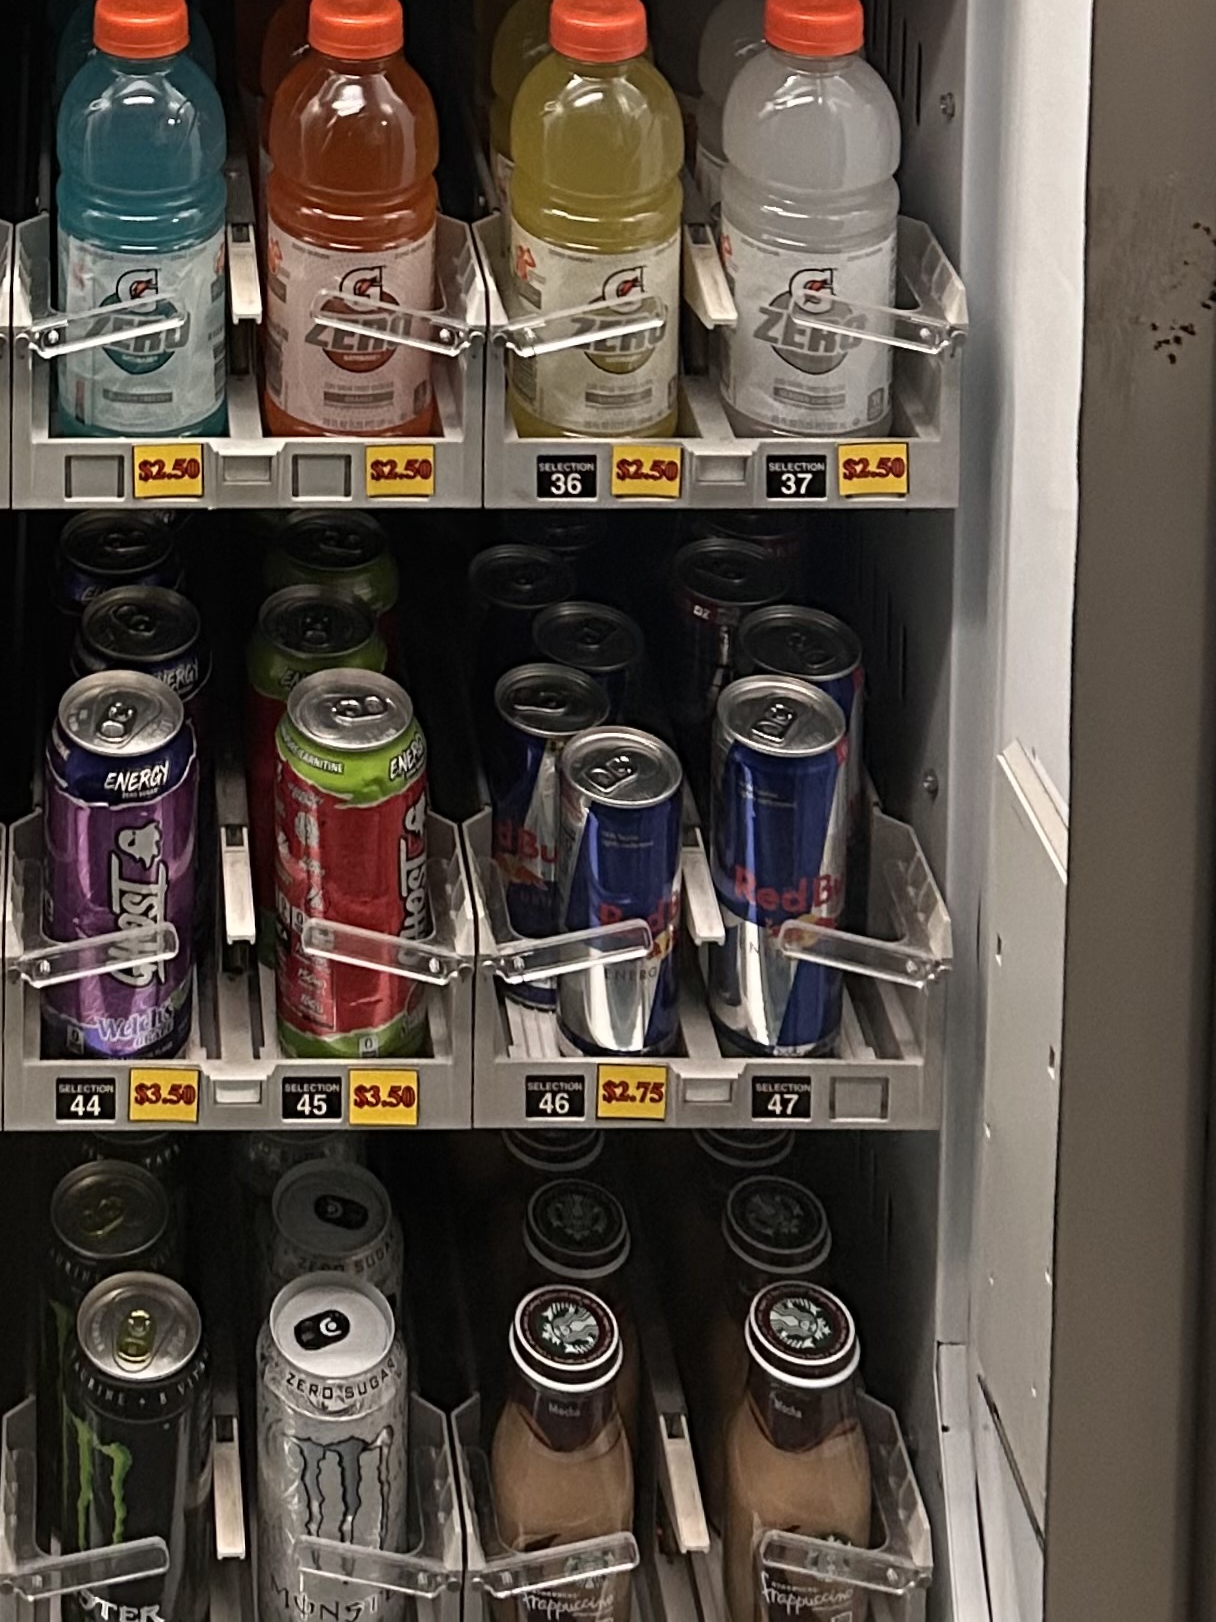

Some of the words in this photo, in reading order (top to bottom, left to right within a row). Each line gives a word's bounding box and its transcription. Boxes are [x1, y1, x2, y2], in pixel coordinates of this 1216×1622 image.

[303, 312, 413, 353] ZERO
[752, 305, 869, 355] ZERO
[137, 458, 201, 481] $2.50
[370, 458, 433, 481] $2.50
[538, 462, 595, 472] SELECTION
[616, 458, 680, 481] $2.50
[768, 461, 826, 471] SELECTION
[842, 457, 906, 480] $2.50
[550, 473, 582, 495] 36
[781, 473, 813, 495] 37
[103, 759, 171, 793] ENERGY
[734, 863, 809, 912] Red
[105, 852, 168, 987] GHOST
[58, 1083, 115, 1093] SELECTION
[134, 1082, 197, 1106] $3.50
[284, 1082, 340, 1092] SELECTION
[353, 1083, 416, 1108] $3.50
[527, 1081, 583, 1091] SELECTION
[602, 1080, 665, 1105] $2.75
[755, 1082, 811, 1092] SELECTION
[70, 1094, 101, 1116] 44
[296, 1093, 327, 1116] 45
[539, 1092, 570, 1114] 46
[767, 1093, 799, 1115] 47
[286, 1371, 334, 1400] ZERO
[343, 1358, 395, 1399] SUGAR
[548, 1402, 582, 1419] Mocha
[773, 1400, 803, 1420] Mocha
[521, 1586, 614, 1622] Frappuccino
[761, 1571, 854, 1621] Frappuccino
